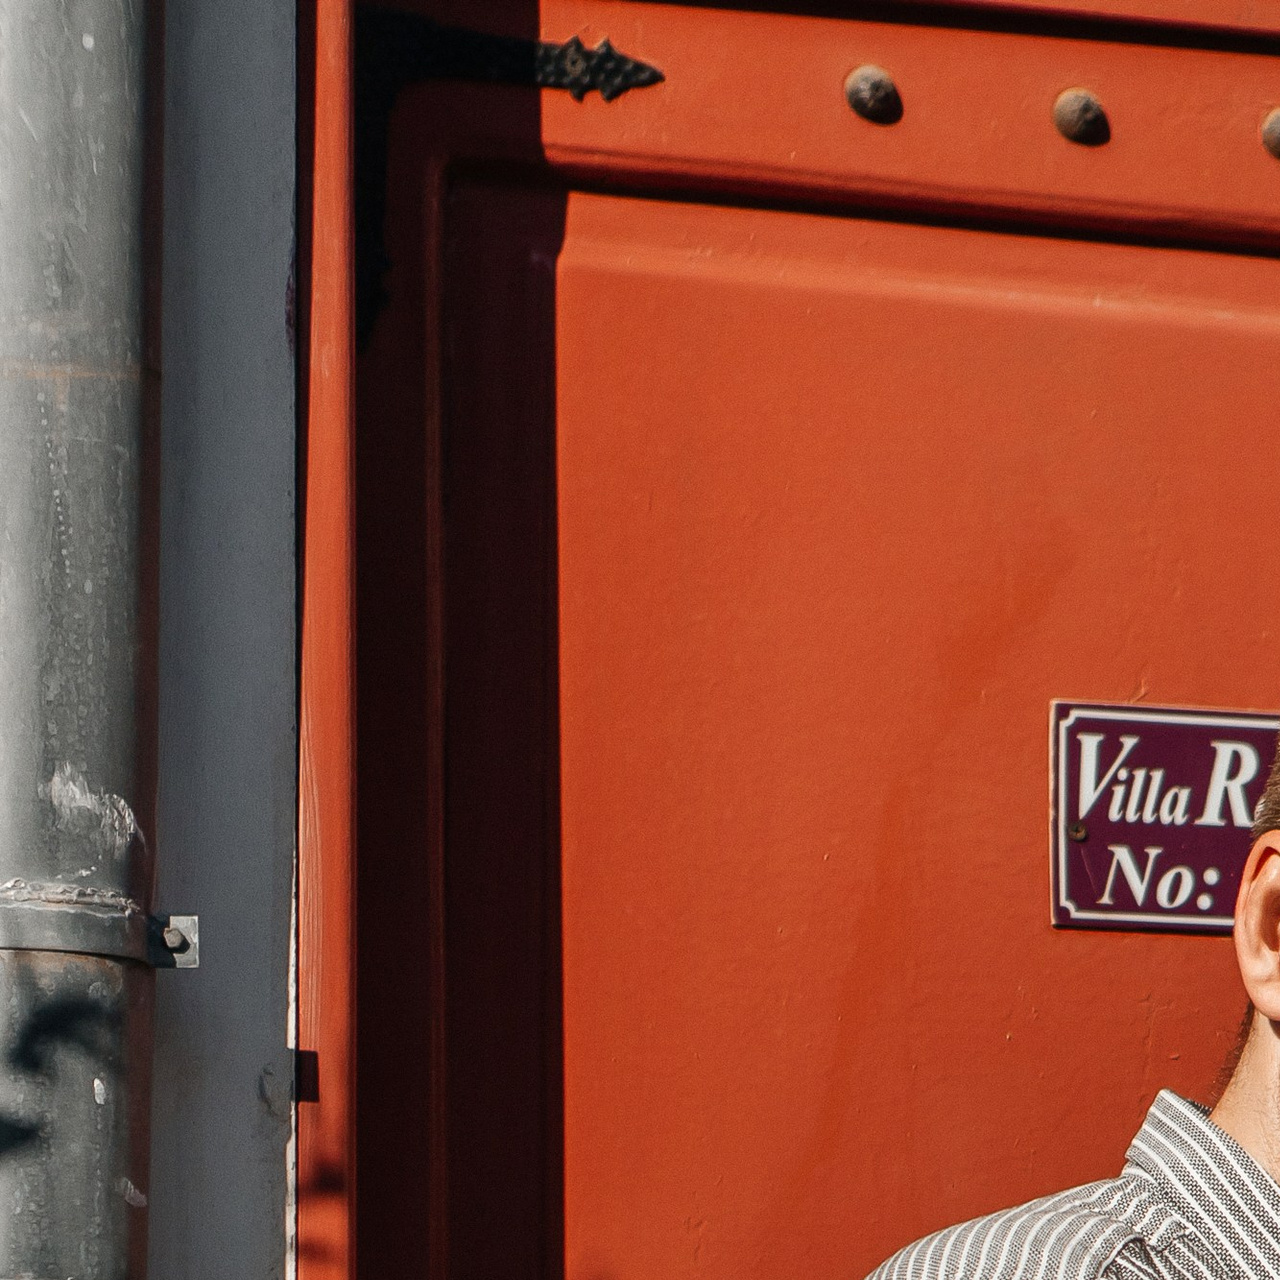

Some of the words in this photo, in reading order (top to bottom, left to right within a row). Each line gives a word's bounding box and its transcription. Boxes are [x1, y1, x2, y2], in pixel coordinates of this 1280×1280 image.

[1075, 731, 1192, 827] Villa
[1193, 740, 1264, 828] R
[1096, 843, 1221, 911] No:
